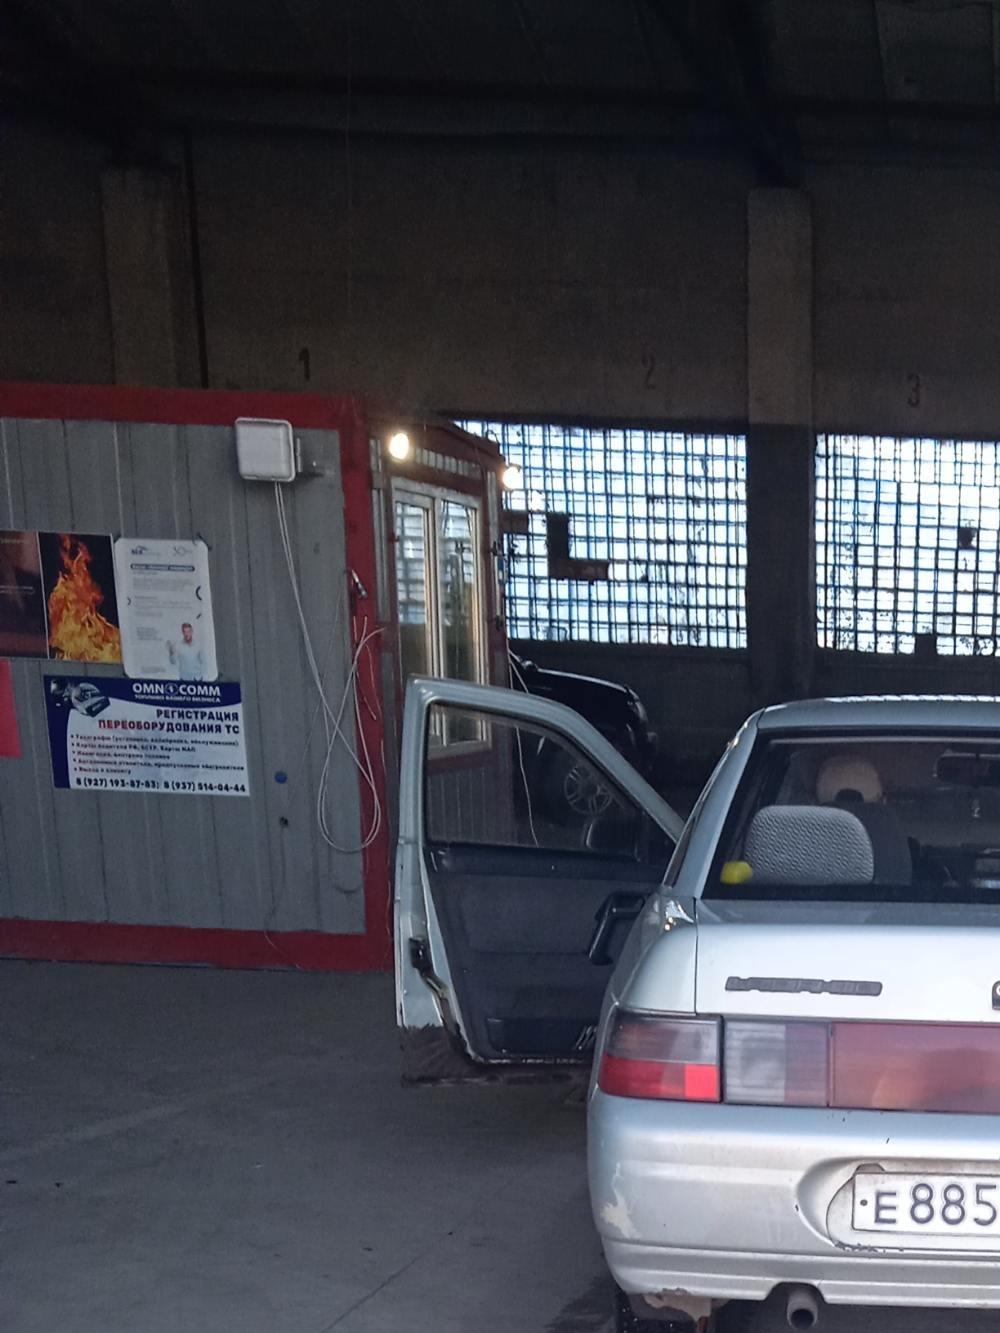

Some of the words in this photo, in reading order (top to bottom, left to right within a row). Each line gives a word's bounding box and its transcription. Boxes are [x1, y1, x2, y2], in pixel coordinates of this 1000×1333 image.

[298, 347, 310, 381] 1
[641, 354, 656, 390] 2
[907, 372, 920, 408] 3
[98, 719, 222, 734] ПЕРЕОБОРУДОВАНИЯ
[225, 724, 240, 734] ТС
[156, 709, 239, 723] РЕГИСТРАЦИЯ
